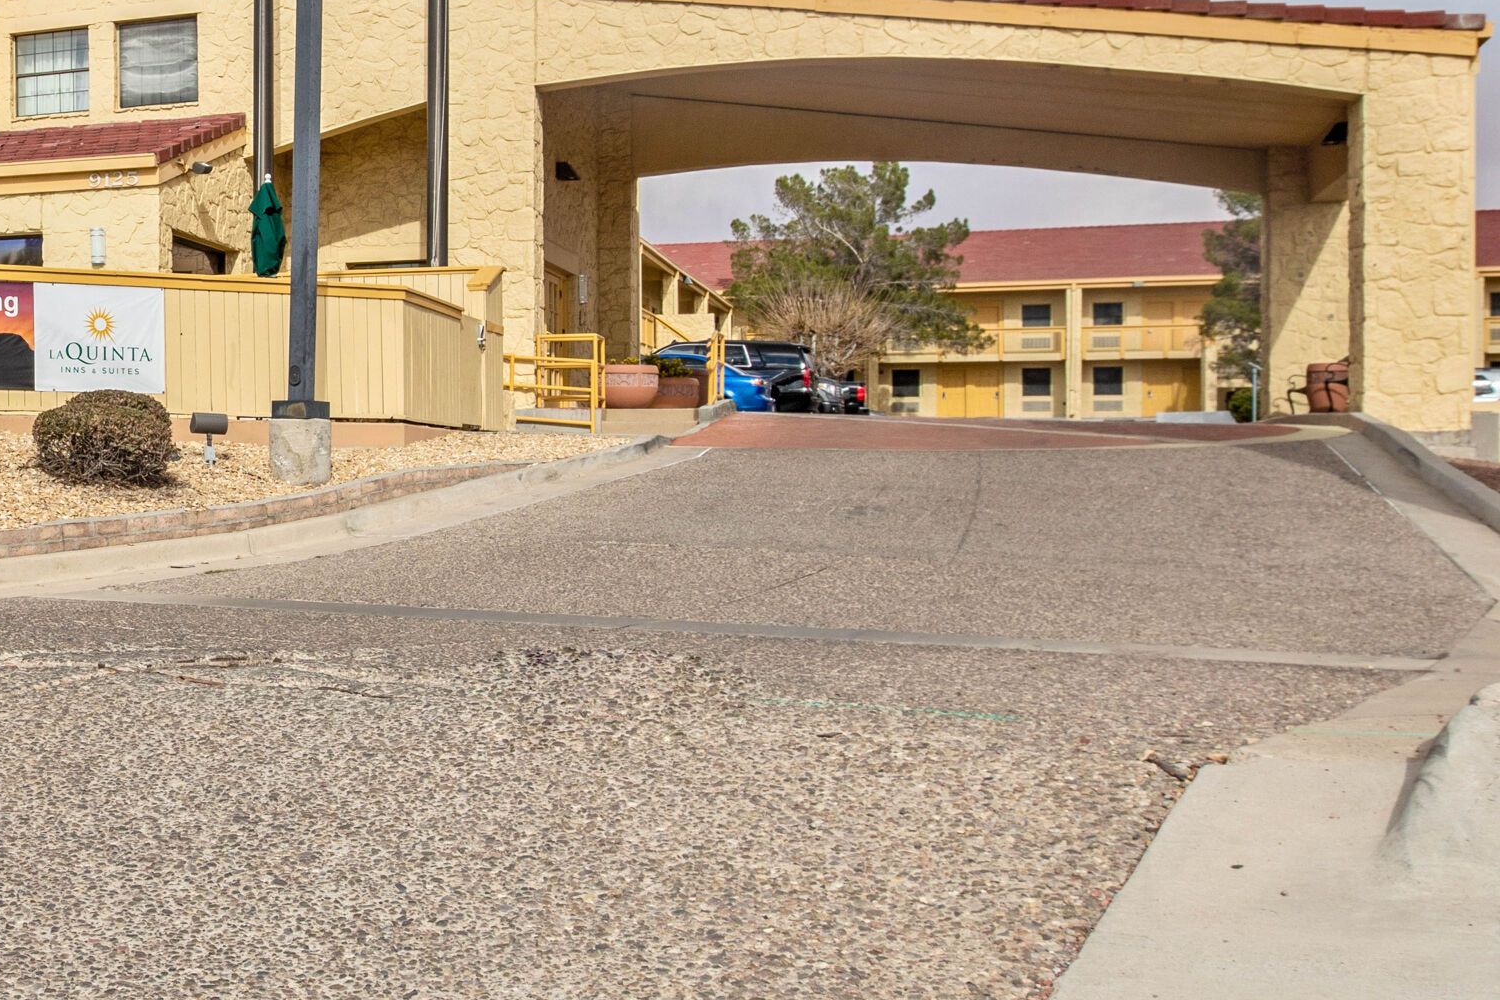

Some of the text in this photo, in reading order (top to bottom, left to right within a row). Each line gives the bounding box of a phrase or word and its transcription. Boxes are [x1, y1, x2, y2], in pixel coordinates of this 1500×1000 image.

[88, 170, 139, 188] 9125
[65, 341, 152, 365] QUINTA
[60, 366, 86, 374] INNS
[102, 367, 140, 375] SUITES
